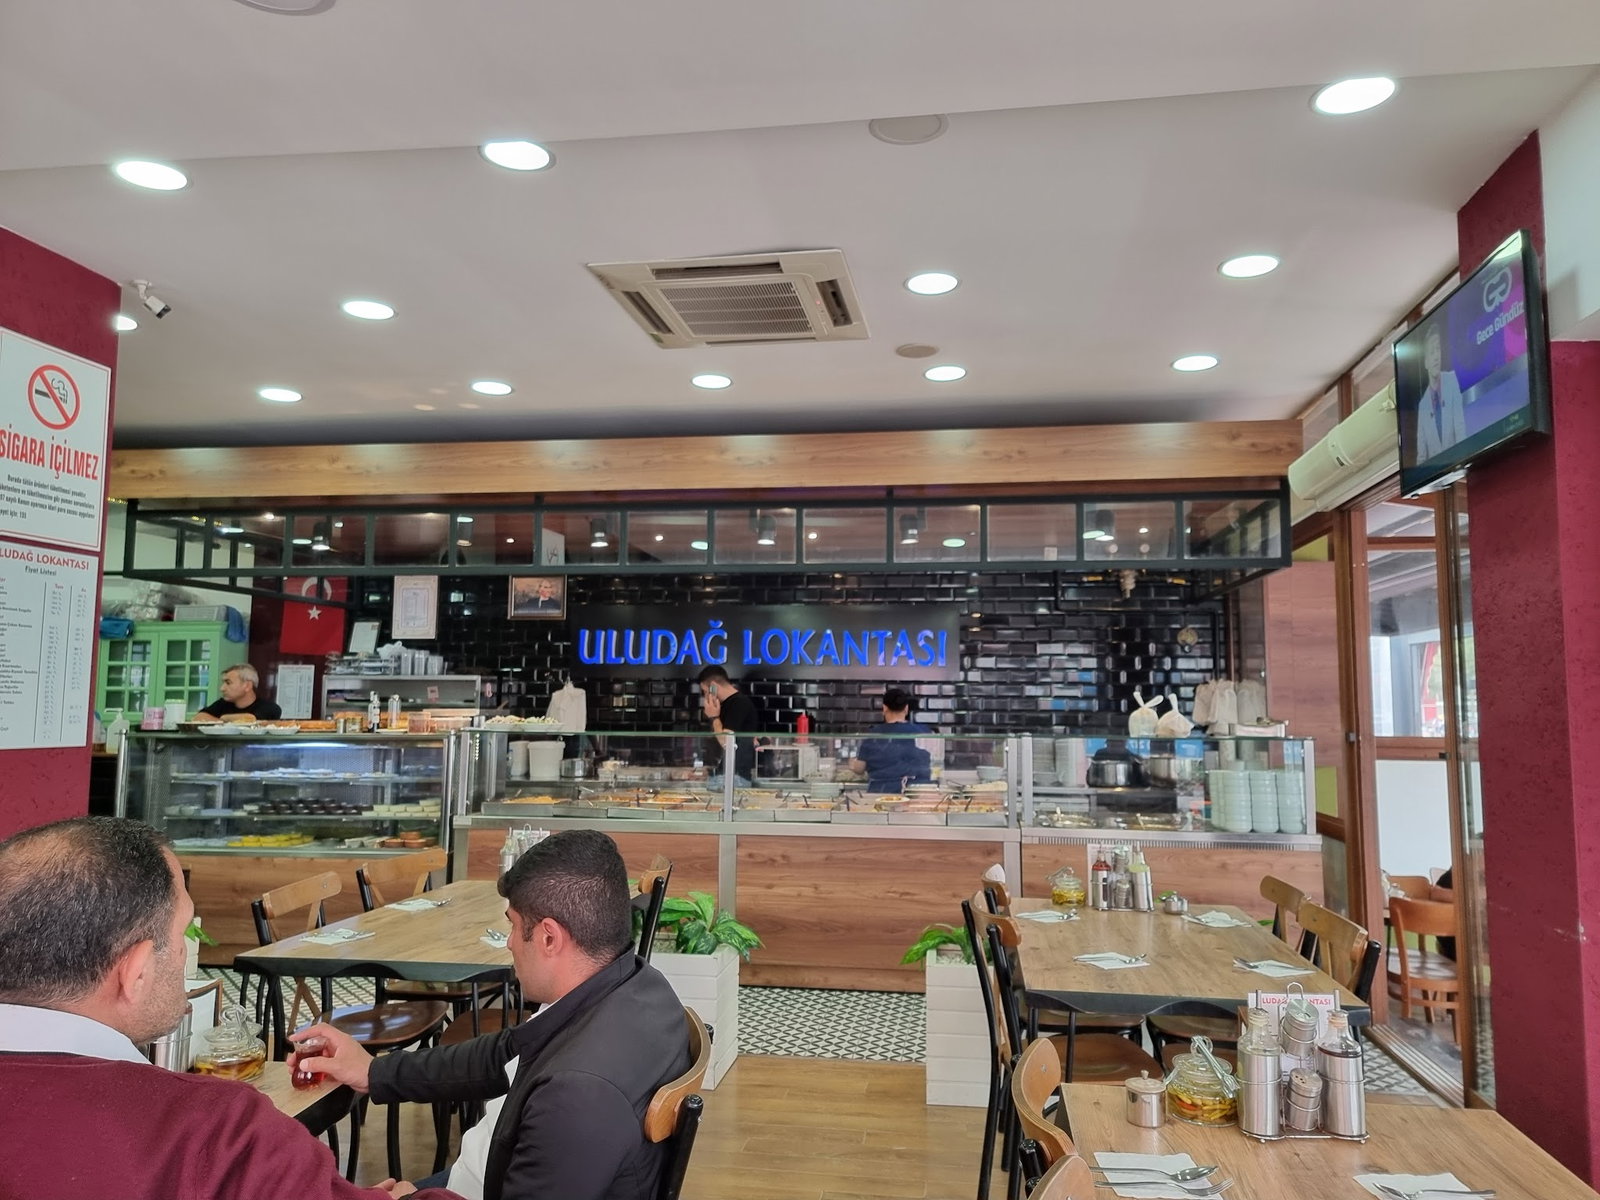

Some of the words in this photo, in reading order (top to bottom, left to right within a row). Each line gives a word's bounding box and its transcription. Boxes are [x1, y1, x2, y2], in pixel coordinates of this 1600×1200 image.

[1476, 324, 1495, 345] Gece
[1494, 301, 1525, 331] Gündüz
[0, 423, 45, 468] SİGARA
[49, 435, 98, 480] İÇİLMEZ
[36, 554, 89, 570] LOKANTASI
[578, 619, 729, 667] ULUDAĞ
[742, 628, 949, 668] LOKANTASI
